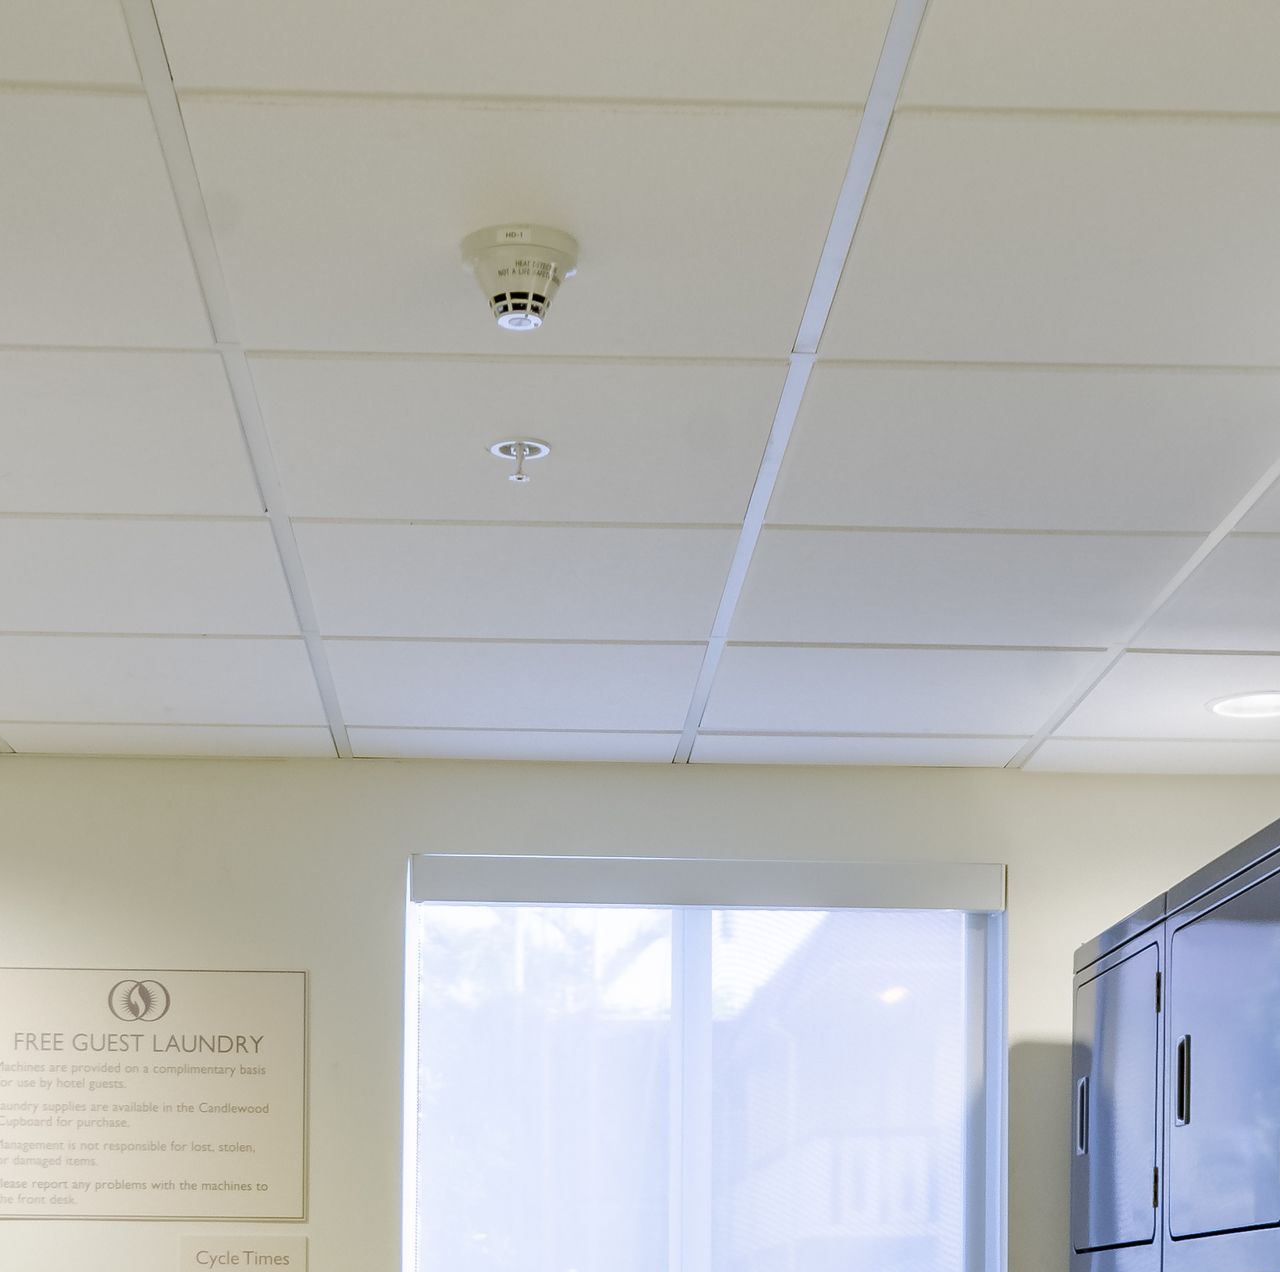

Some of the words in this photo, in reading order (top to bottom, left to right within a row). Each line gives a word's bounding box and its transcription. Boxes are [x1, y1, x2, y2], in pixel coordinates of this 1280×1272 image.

[13, 1031, 65, 1051] FREE
[72, 1033, 145, 1053] GUEST
[153, 1034, 265, 1054] LAUNDRY
[49, 1064, 68, 1073] are
[71, 1062, 121, 1076] provided
[124, 1065, 139, 1074] on
[143, 1065, 149, 1074] a
[153, 1064, 236, 1077] complimentary
[240, 1064, 267, 1075] basis
[17, 1079, 36, 1088] use
[39, 1077, 53, 1091] by
[56, 1078, 85, 1089] hotel
[88, 1080, 128, 1092] guests.
[42, 1101, 87, 1114] supplies
[90, 1103, 110, 1112] are
[112, 1101, 159, 1113] available
[162, 1102, 173, 1112] in
[176, 1102, 195, 1113] the
[199, 1102, 270, 1114] Candlewood
[56, 1116, 74, 1127] for
[77, 1117, 131, 1130] purchase.
[68, 1141, 77, 1151] is
[80, 1142, 100, 1151] not
[103, 1141, 167, 1154] responsible
[170, 1141, 188, 1152] for
[218, 1142, 256, 1154] stolen,
[13, 1155, 63, 1168] damaged
[65, 1157, 98, 1167] items.
[31, 1180, 69, 1192] report
[72, 1181, 91, 1192] any
[95, 1180, 148, 1192] problems
[151, 1180, 176, 1191] with
[179, 1180, 198, 1191] the
[201, 1180, 253, 1192] machines
[256, 1182, 269, 1192] to
[17, 1194, 47, 1205] front
[49, 1194, 78, 1206] desk.
[195, 1250, 240, 1269] Cycle
[242, 1250, 290, 1266] Times
